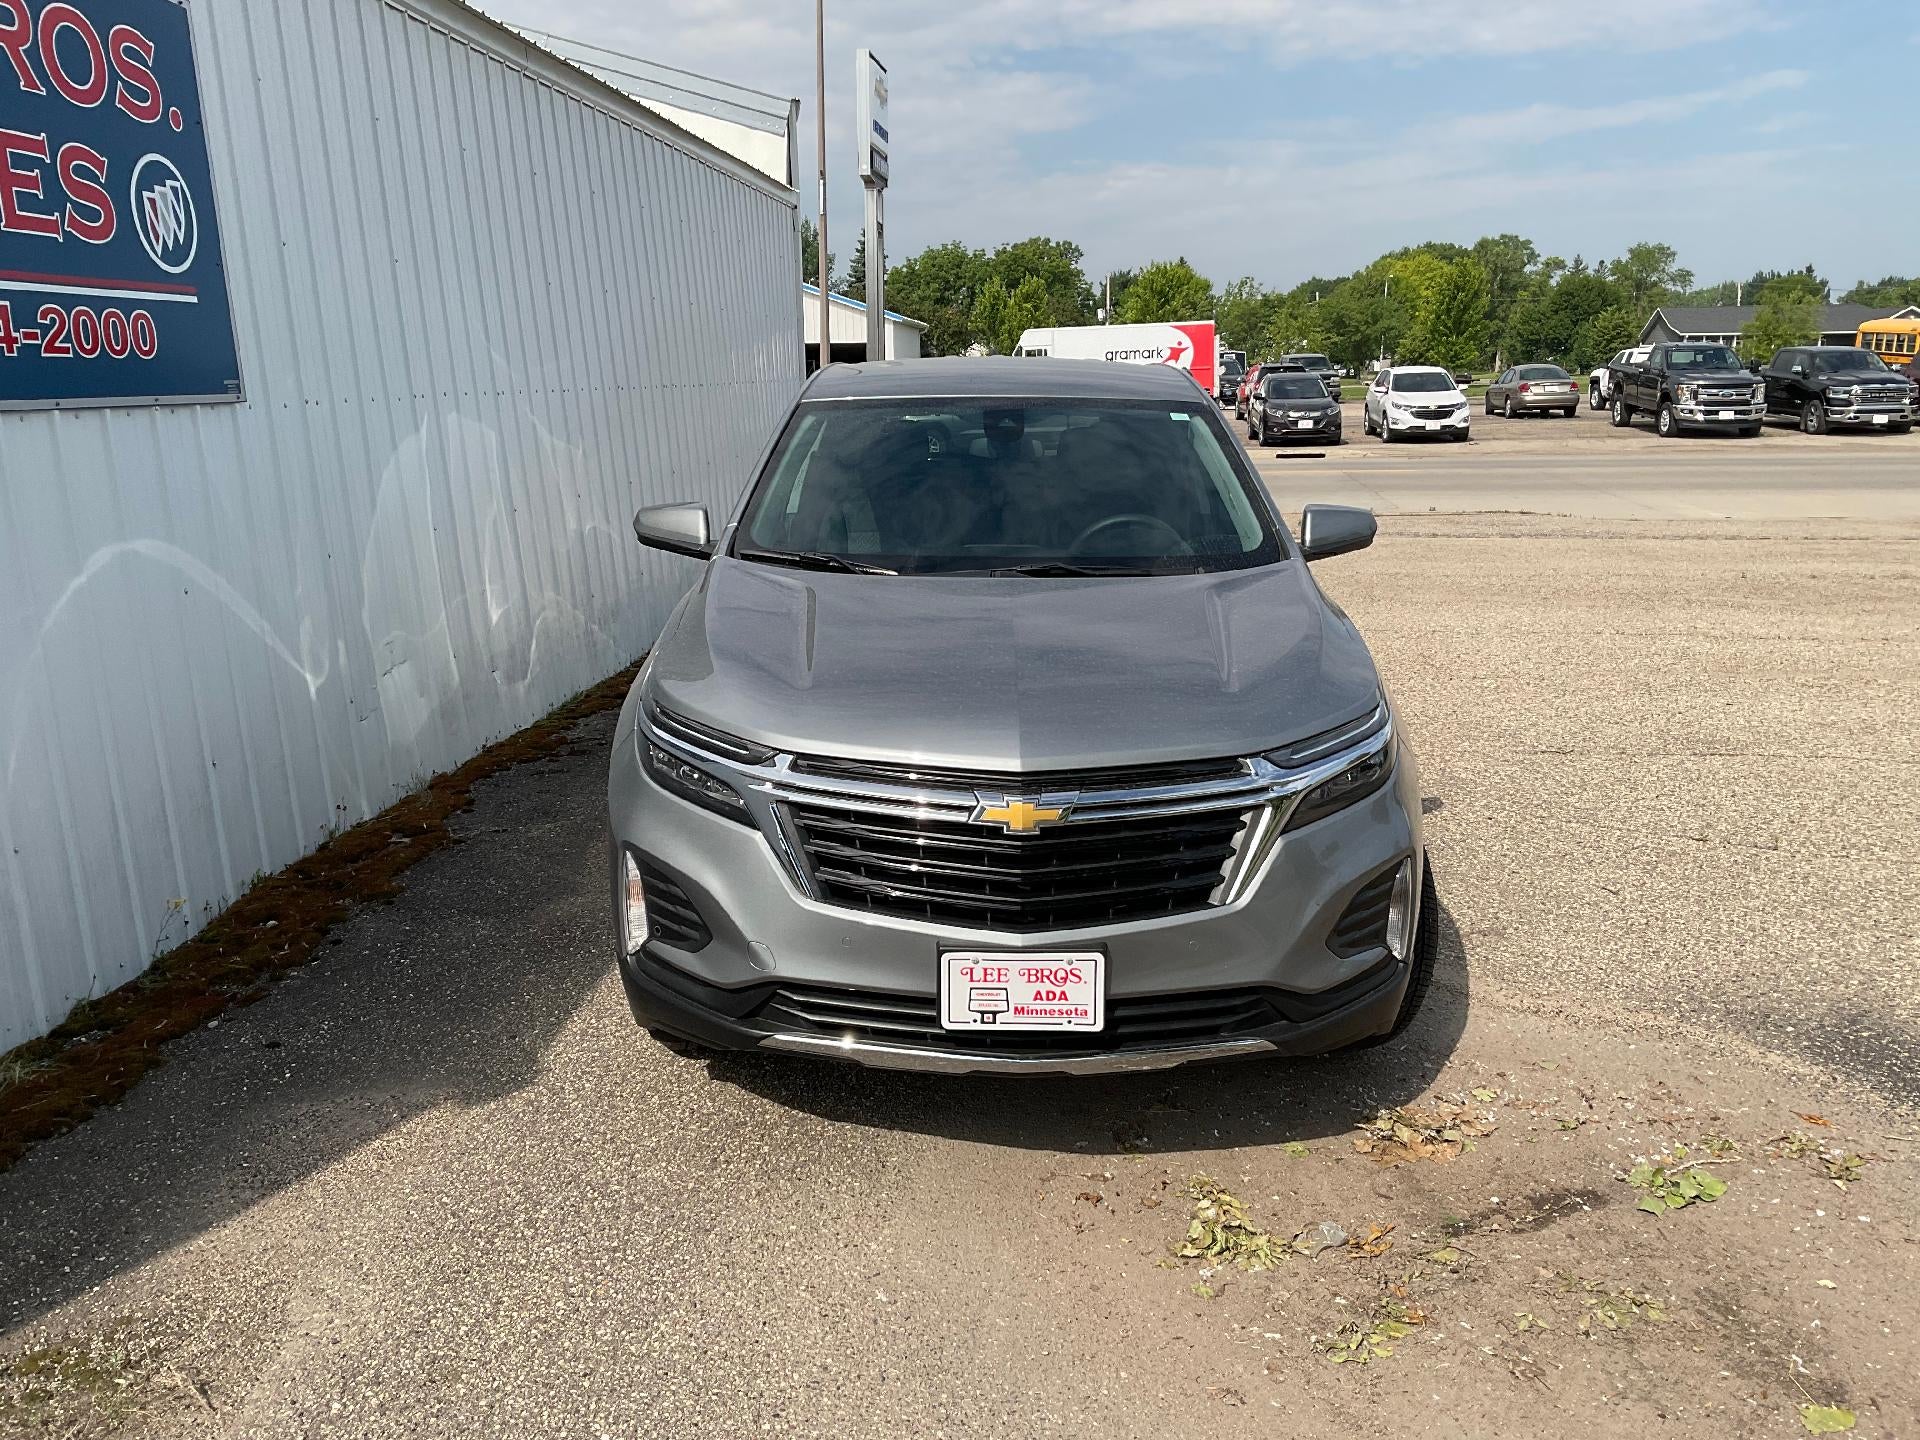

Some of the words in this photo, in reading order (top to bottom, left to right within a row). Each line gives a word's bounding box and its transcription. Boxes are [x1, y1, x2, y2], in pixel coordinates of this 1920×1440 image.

[0, 129, 117, 244] ES
[960, 967, 1010, 983] LEE
[1018, 967, 1088, 987] BROS.
[1033, 990, 1069, 1001] ADA
[1013, 1006, 1088, 1017] Minnesota
